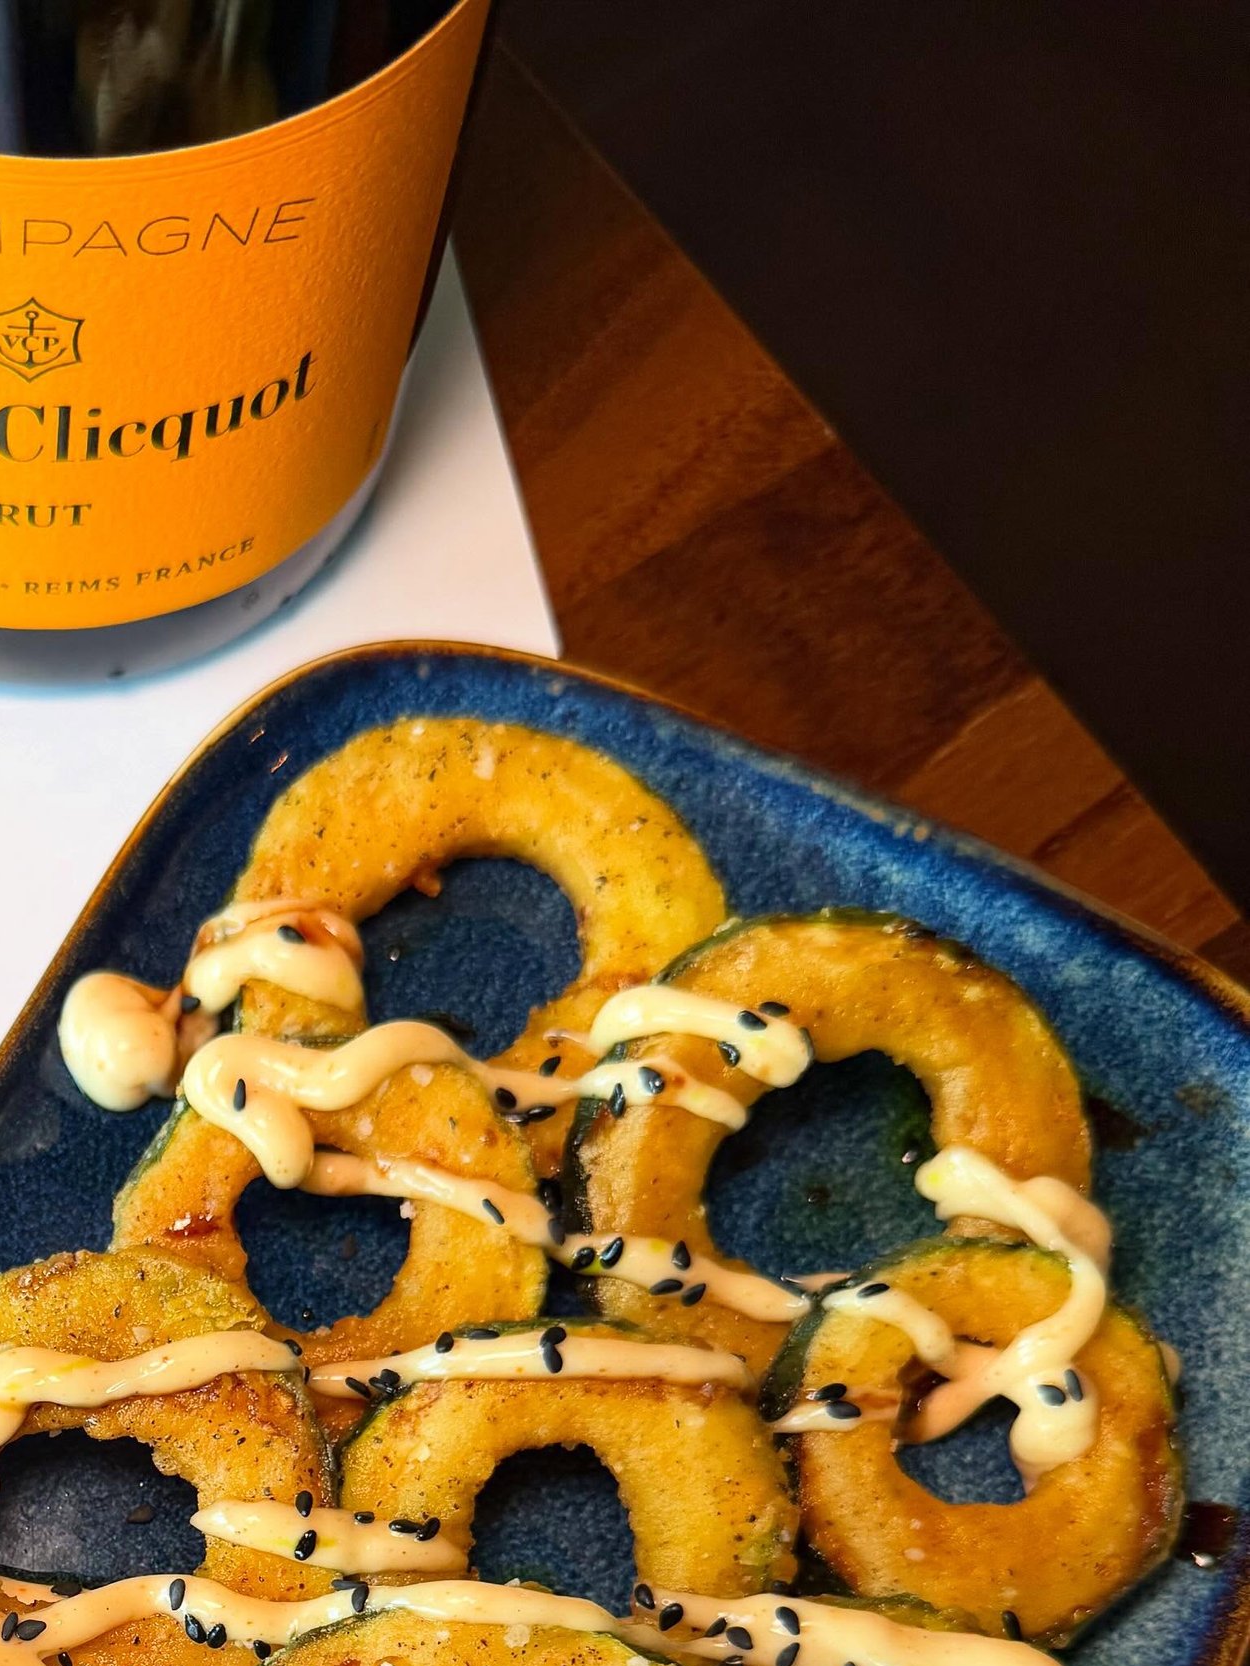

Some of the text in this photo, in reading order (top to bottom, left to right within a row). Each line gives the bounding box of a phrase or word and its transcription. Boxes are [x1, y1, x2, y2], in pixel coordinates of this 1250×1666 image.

[2, 333, 60, 352] VCP
[24, 576, 119, 595] REIMS
[136, 536, 256, 586] FRANCE
